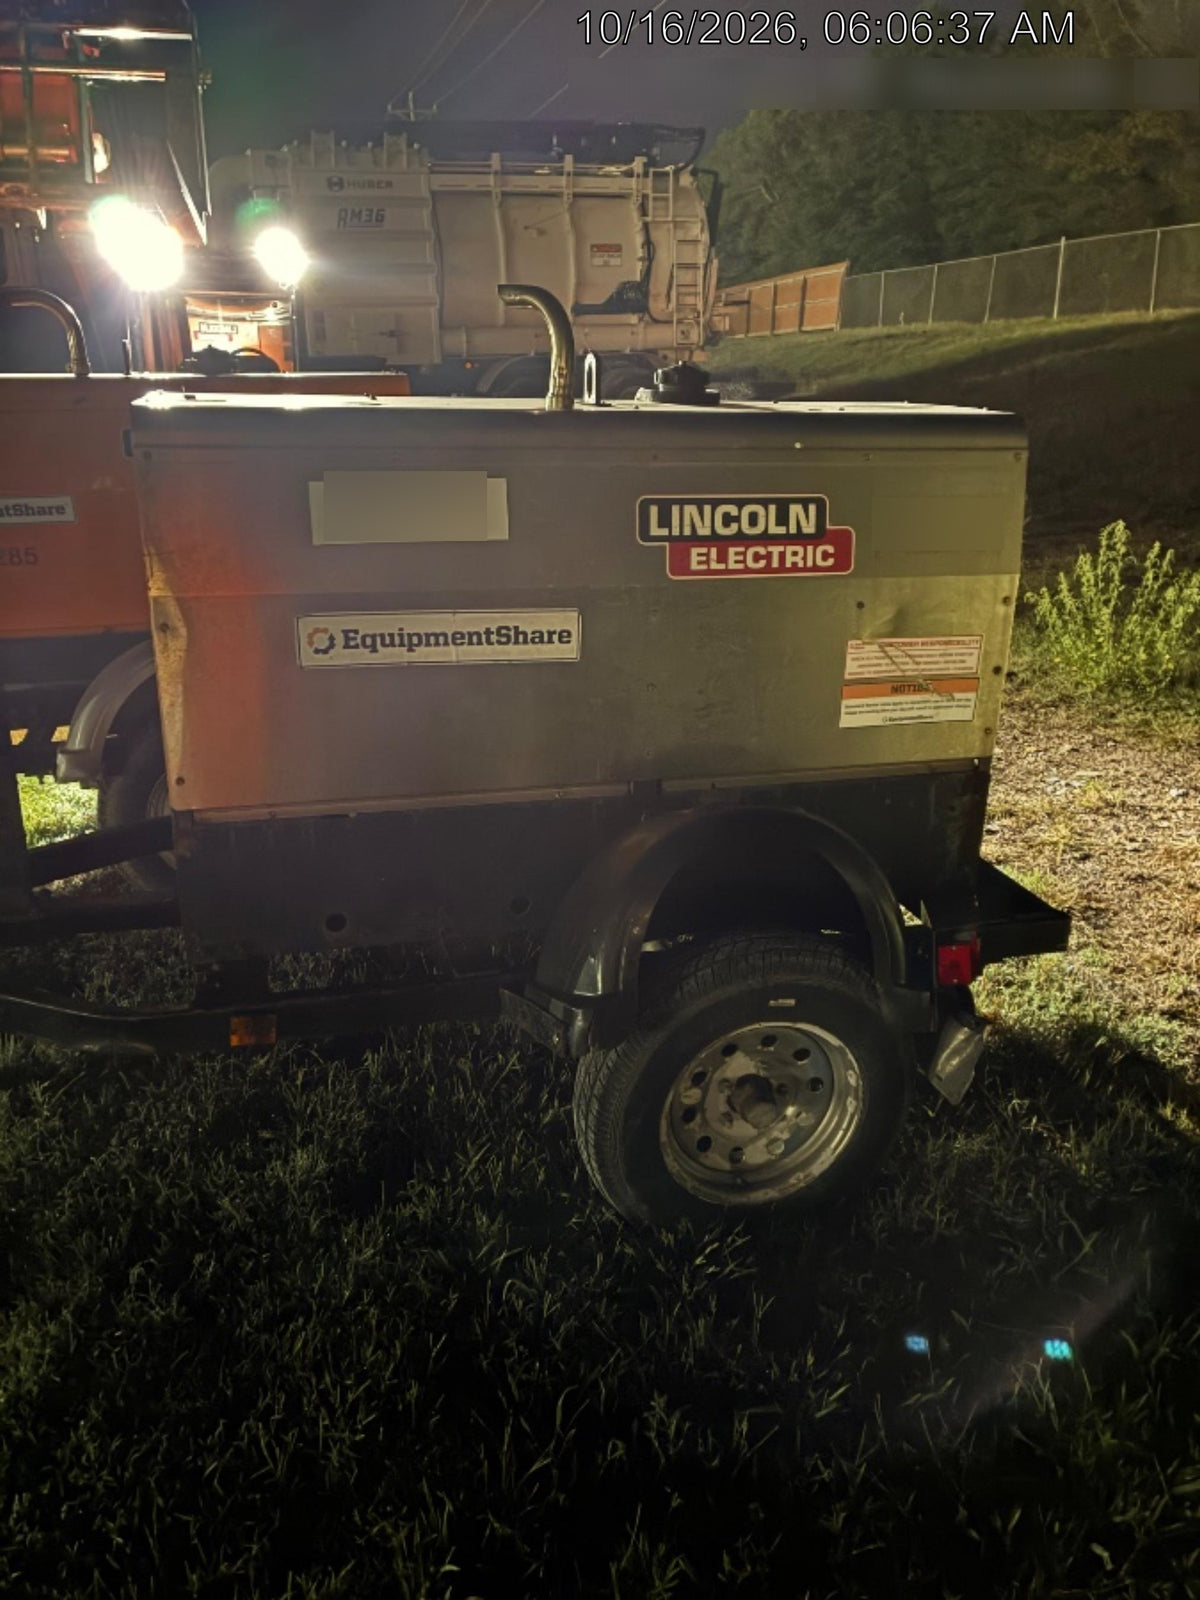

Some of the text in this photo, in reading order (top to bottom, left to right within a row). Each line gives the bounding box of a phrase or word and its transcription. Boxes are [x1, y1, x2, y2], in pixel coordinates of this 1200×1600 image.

[346, 179, 393, 189] HUBER
[649, 503, 817, 536] LINCOLN
[690, 544, 835, 571] ELECTRIC
[341, 626, 572, 653] EquipmentShare
